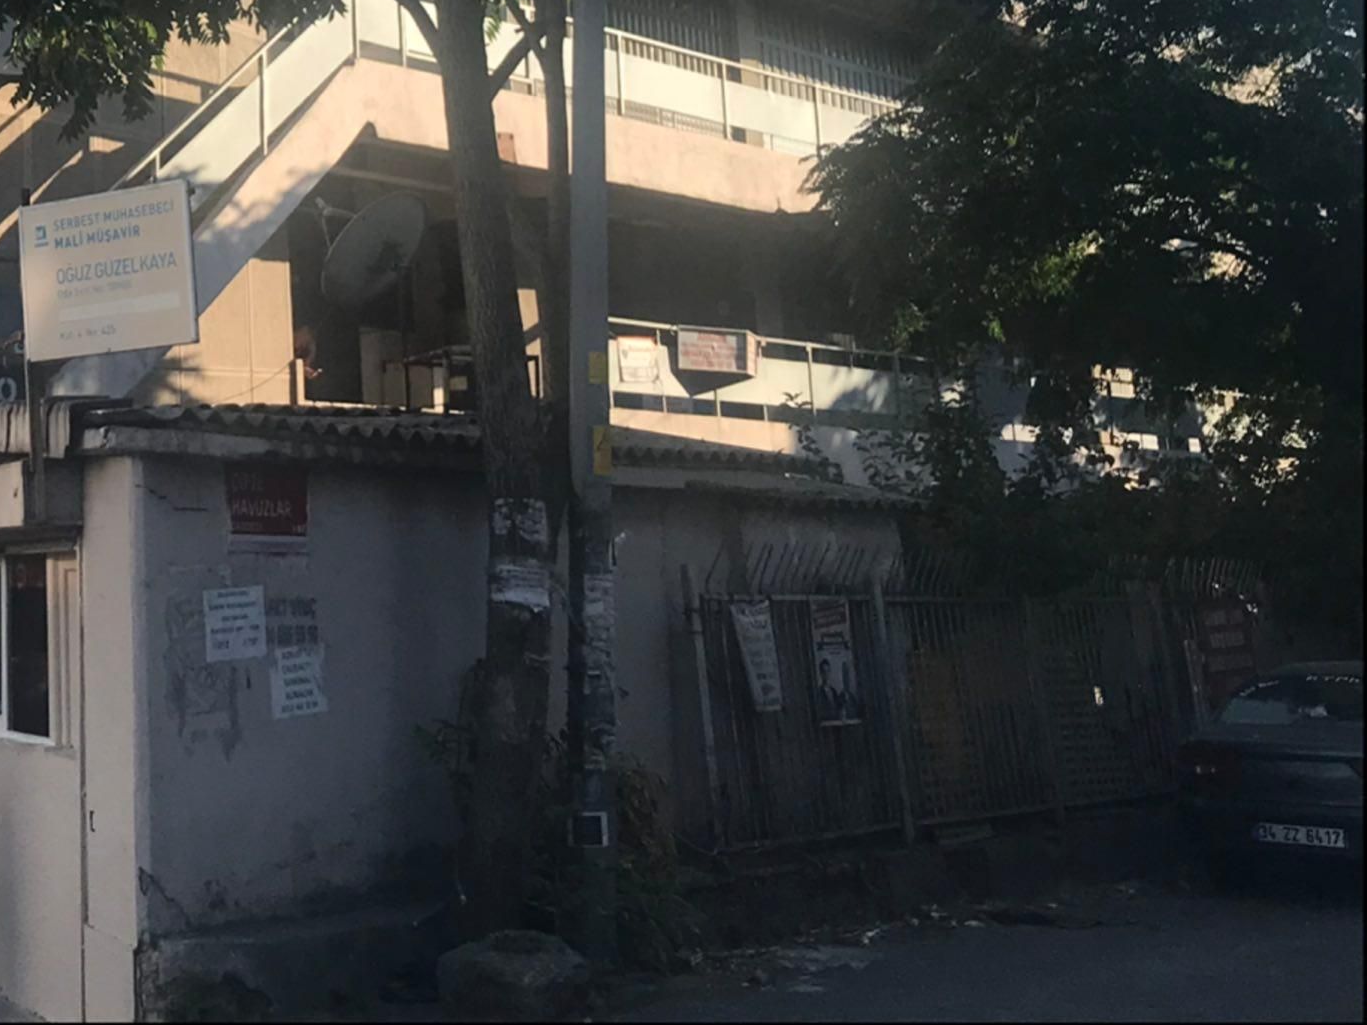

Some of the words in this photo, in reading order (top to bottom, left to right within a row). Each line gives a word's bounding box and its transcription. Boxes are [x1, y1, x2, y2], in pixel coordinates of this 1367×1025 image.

[53, 216, 100, 232] SERBEST
[86, 224, 141, 244] MÜŞAVİR
[1258, 823, 1276, 841] 34
